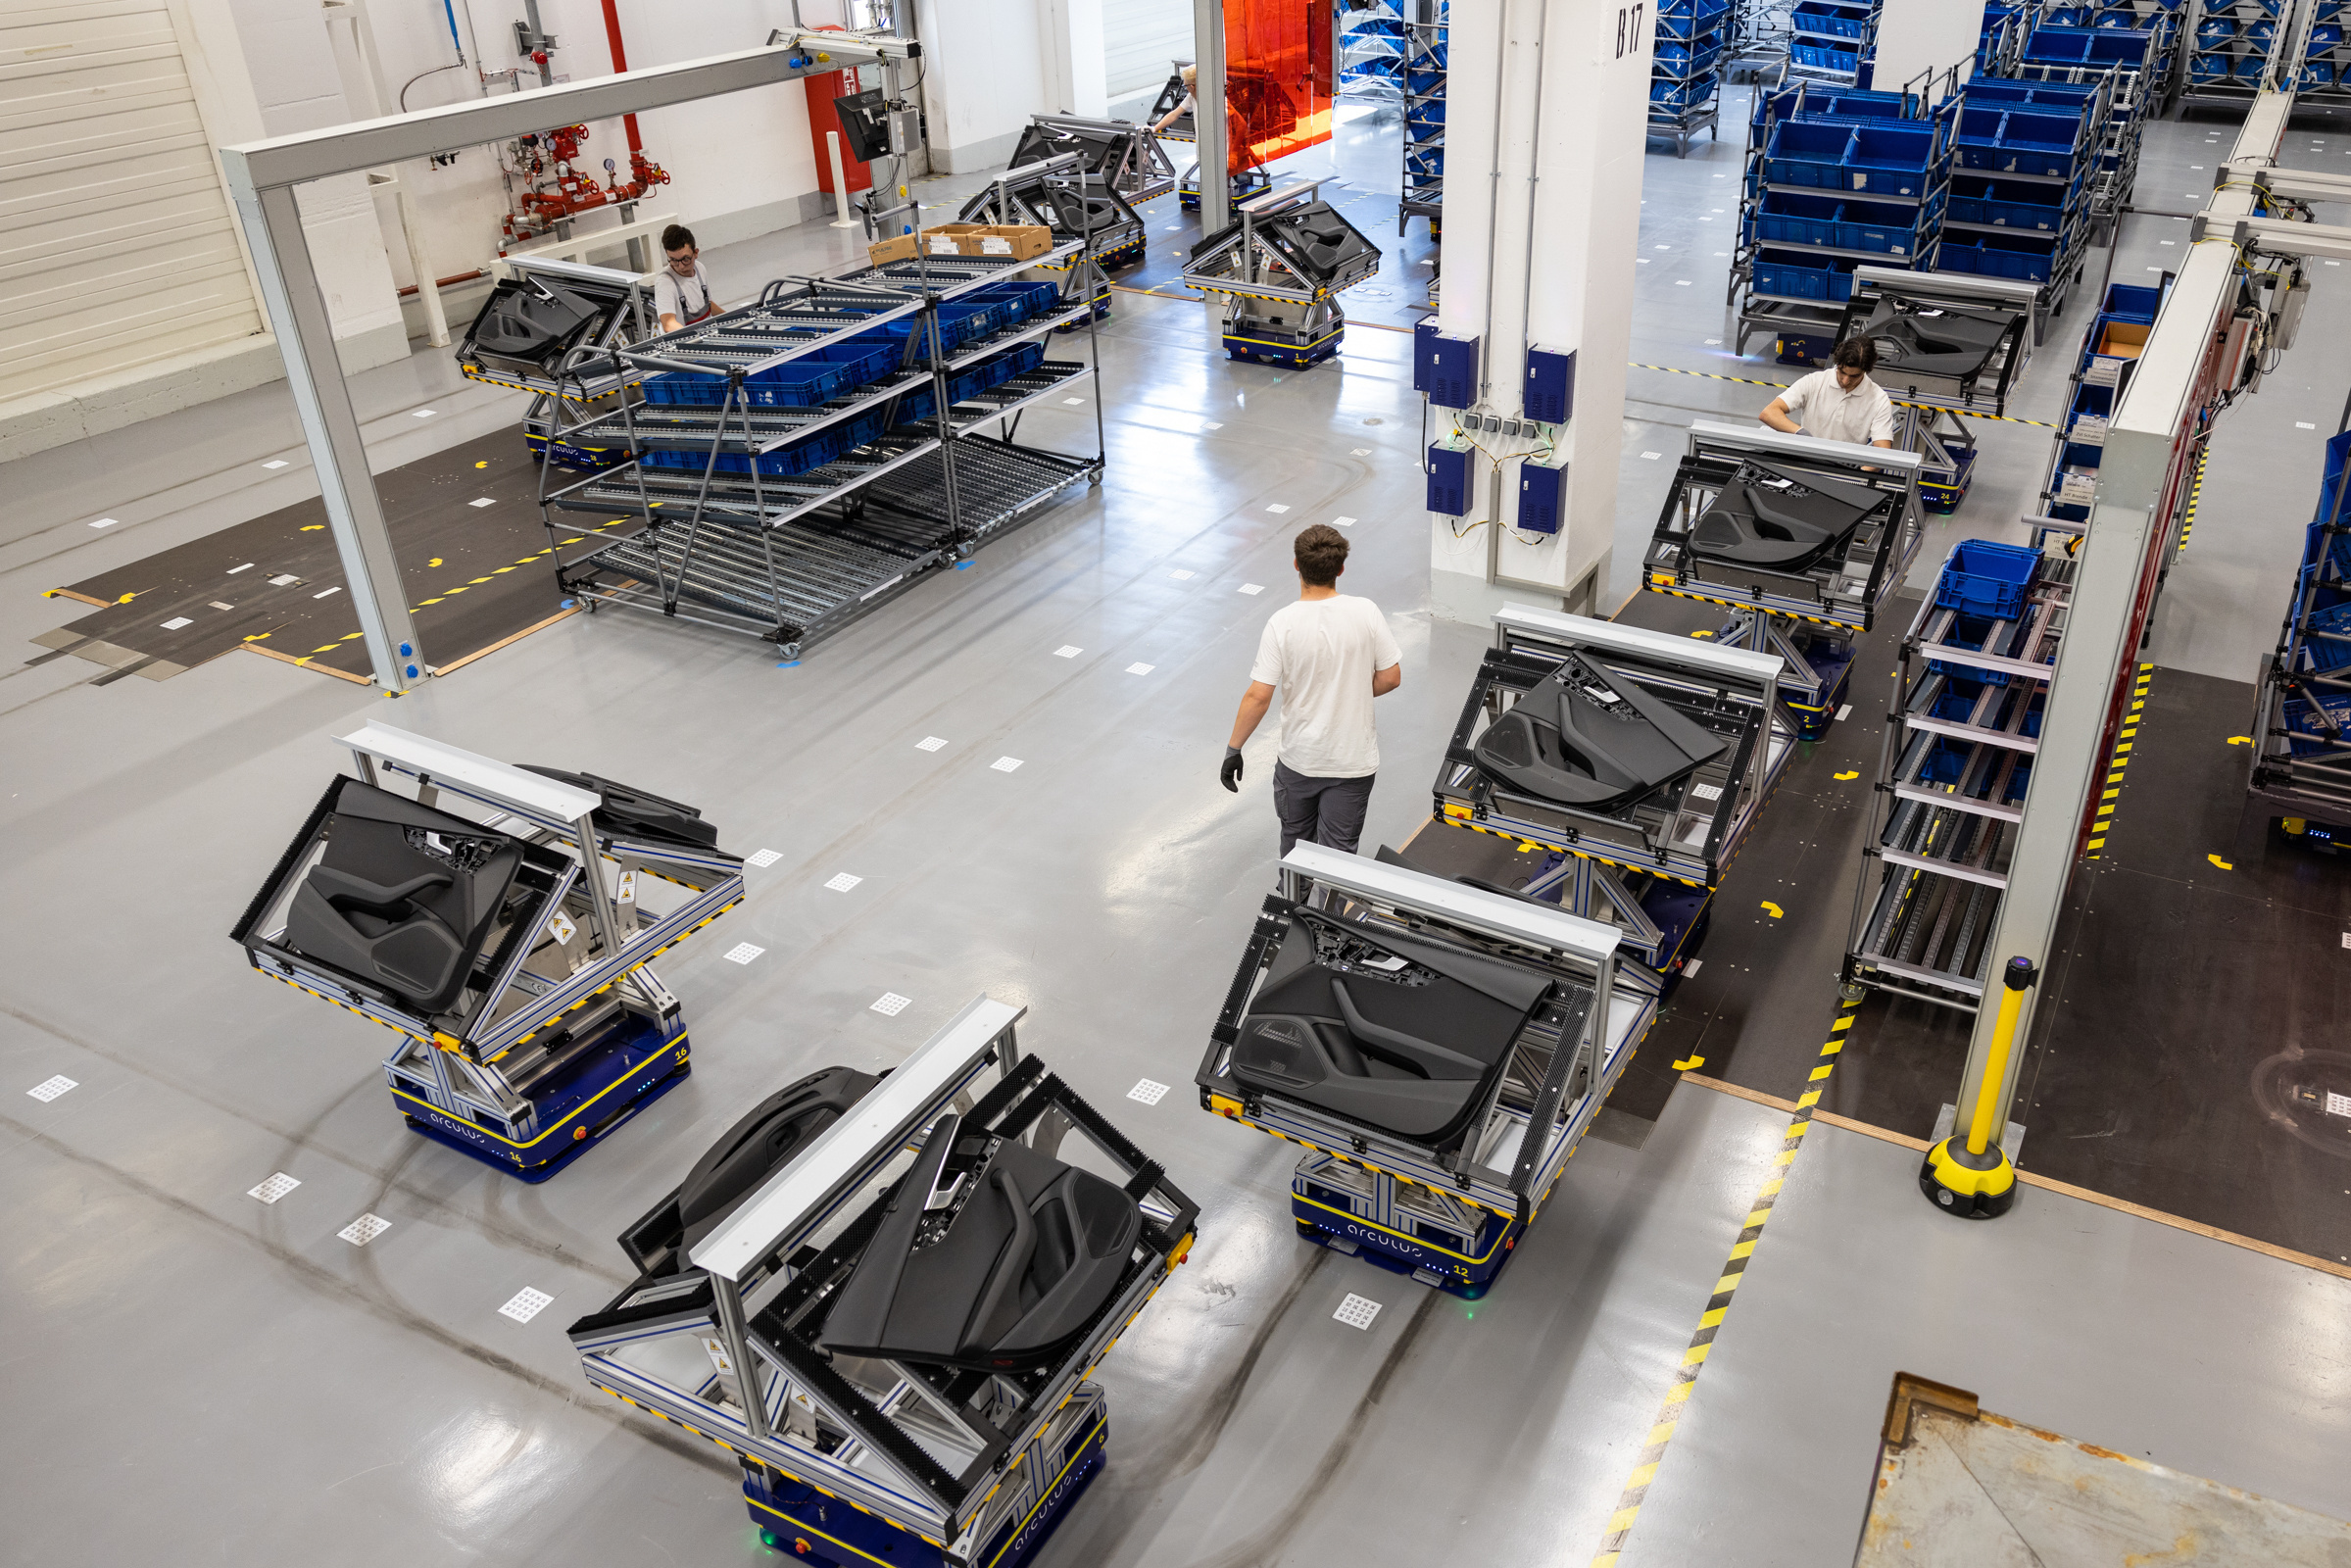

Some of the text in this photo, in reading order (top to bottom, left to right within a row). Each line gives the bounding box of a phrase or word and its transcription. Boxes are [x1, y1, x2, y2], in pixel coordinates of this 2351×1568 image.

[1616, 3, 1642, 59] B 17
[552, 444, 578, 456] rculus
[675, 1047, 687, 1060] 16
[430, 1113, 485, 1144] arculus
[510, 1152, 521, 1163] 16
[1347, 1224, 1422, 1257] arculus
[1453, 1264, 1469, 1278] 12
[1099, 1433, 1104, 1444] 6
[1014, 1475, 1072, 1550] arculus
